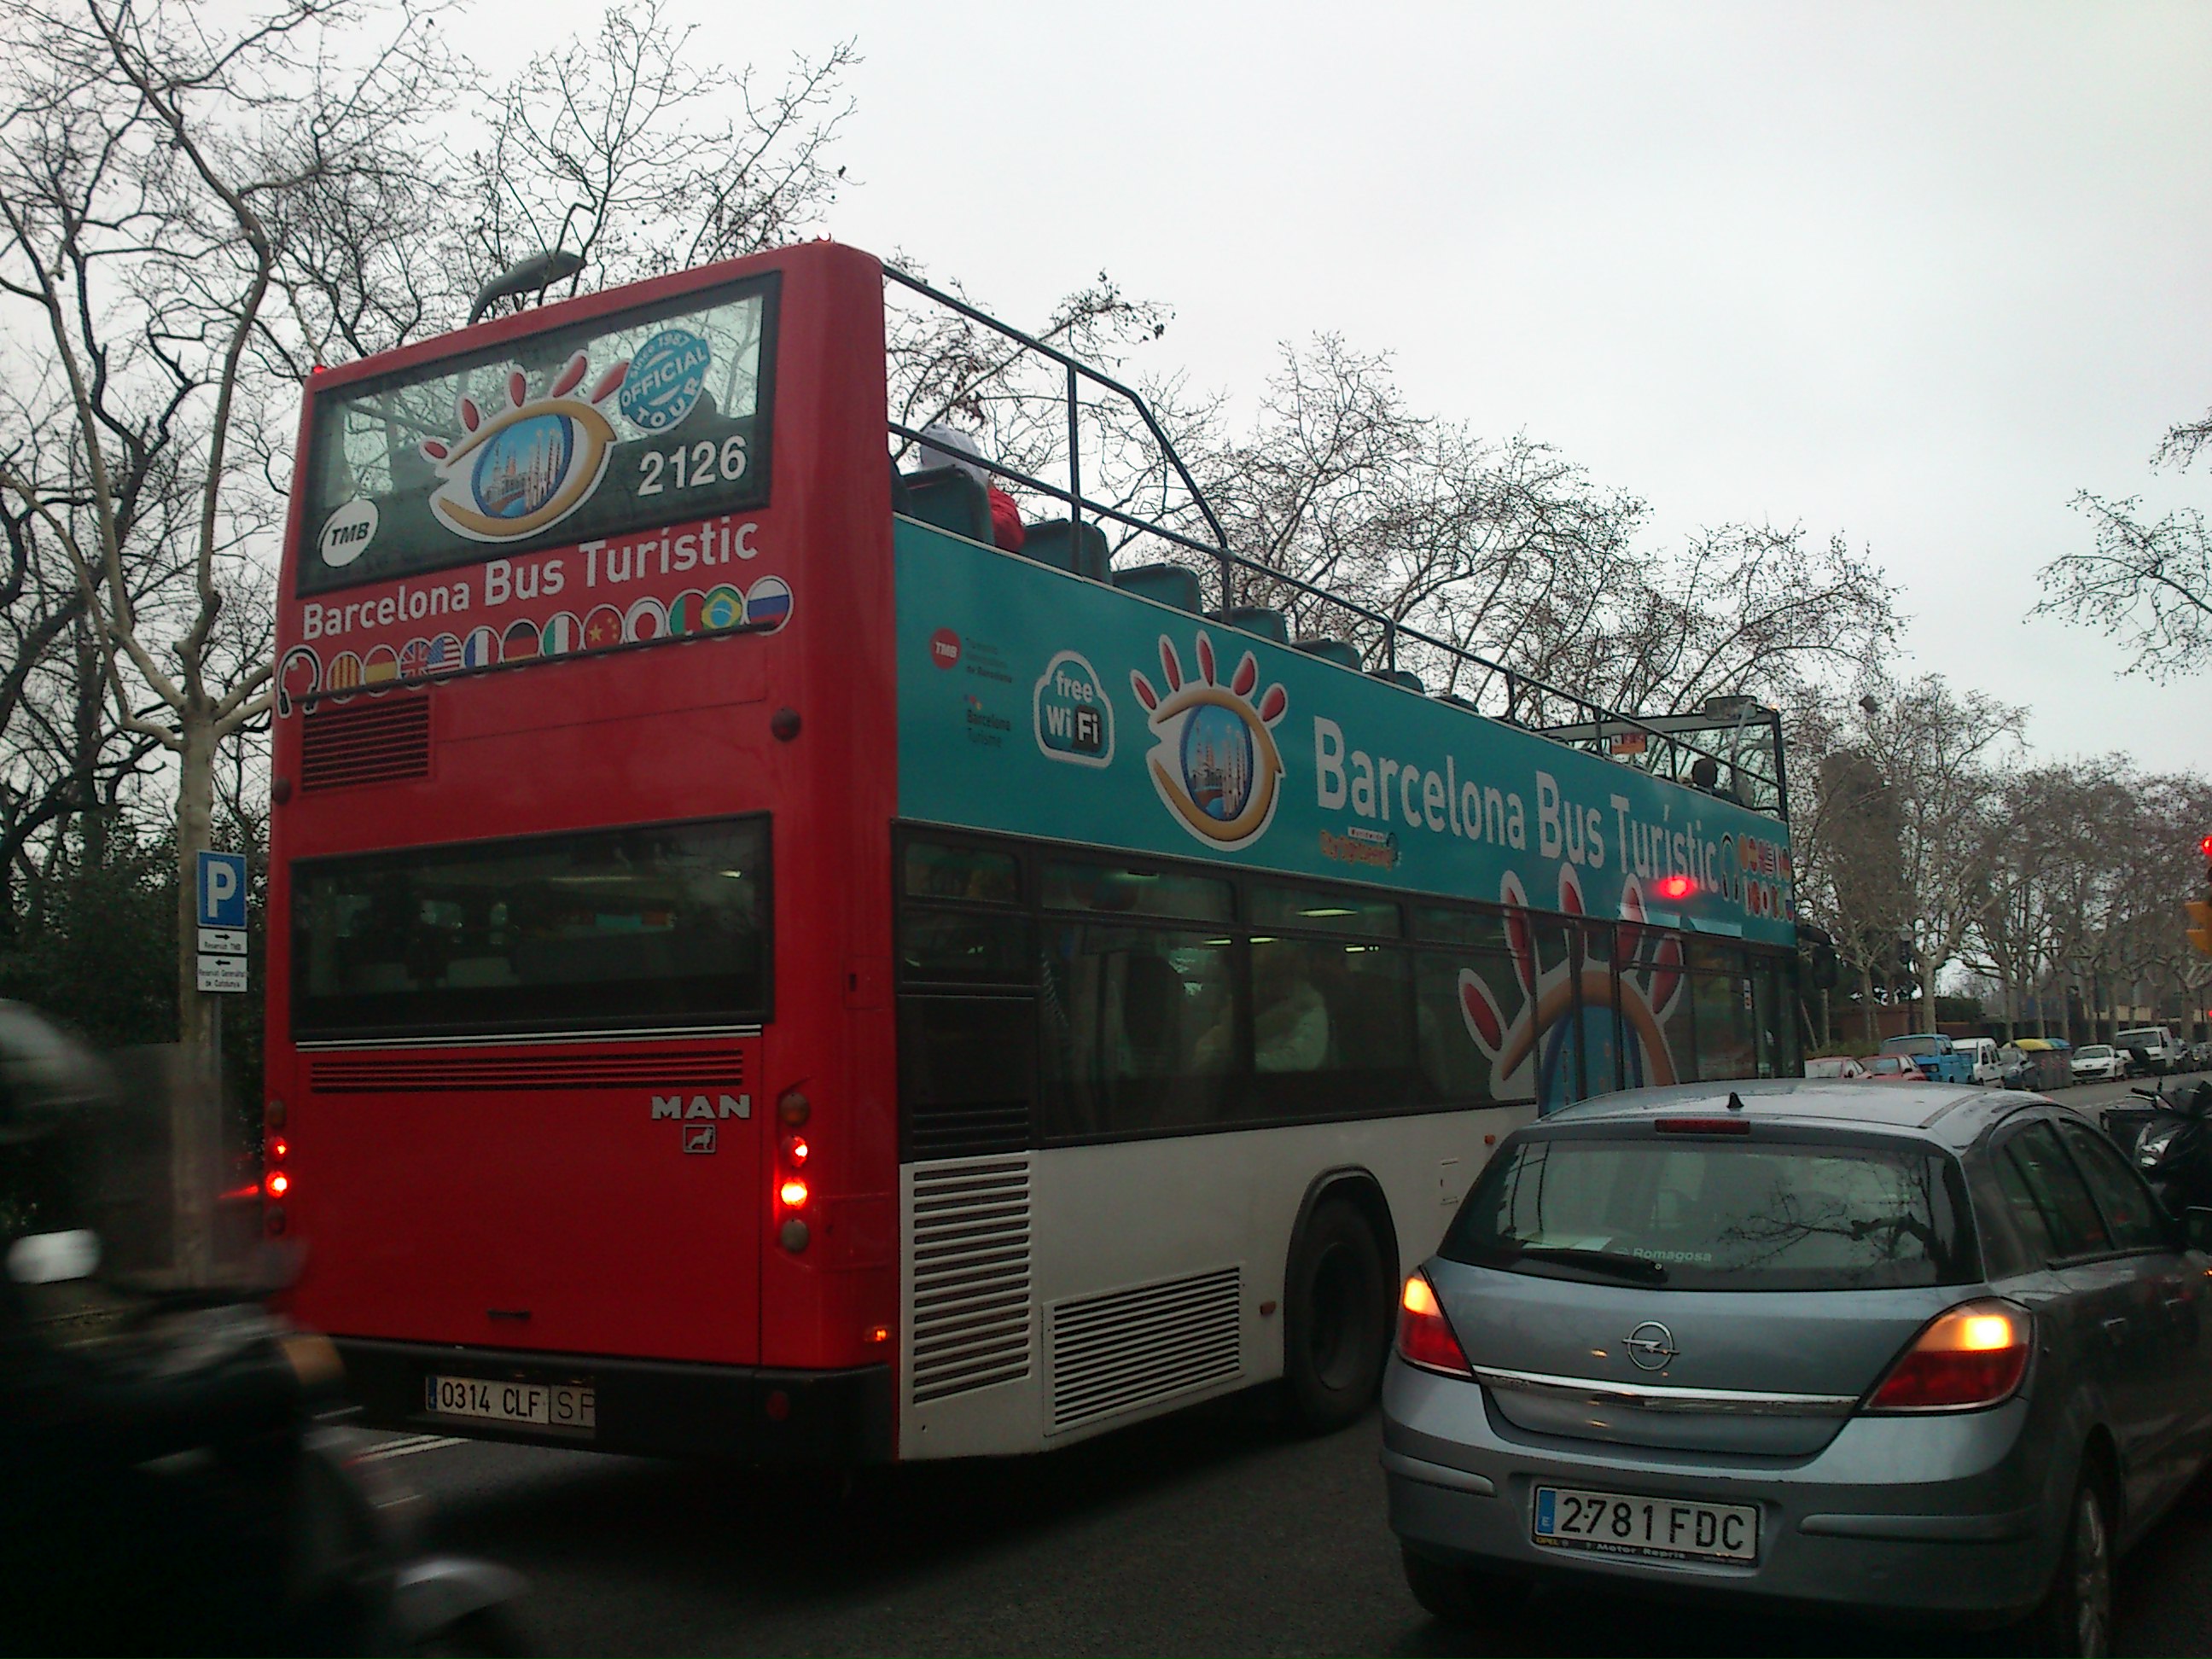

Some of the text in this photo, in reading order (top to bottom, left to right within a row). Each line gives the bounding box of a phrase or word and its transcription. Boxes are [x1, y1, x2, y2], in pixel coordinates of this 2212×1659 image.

[621, 346, 707, 407] OFFICIAL
[637, 376, 699, 428] TOUR
[638, 434, 748, 497] 2126
[331, 521, 370, 546] TMB
[303, 515, 759, 641] Barcelona Bus Turístic
[935, 641, 958, 659] TMB
[1056, 669, 1093, 703] free
[1313, 714, 1527, 851] Barcelona
[1535, 770, 1605, 870] Bus
[1610, 794, 1719, 894] Turístic
[207, 860, 237, 918] P
[651, 1094, 750, 1120] MAN
[1633, 1247, 1713, 1262] Romagosa
[442, 1382, 596, 1420] 0314 CLF SP
[1561, 1497, 1744, 1551] 2781 FDC
